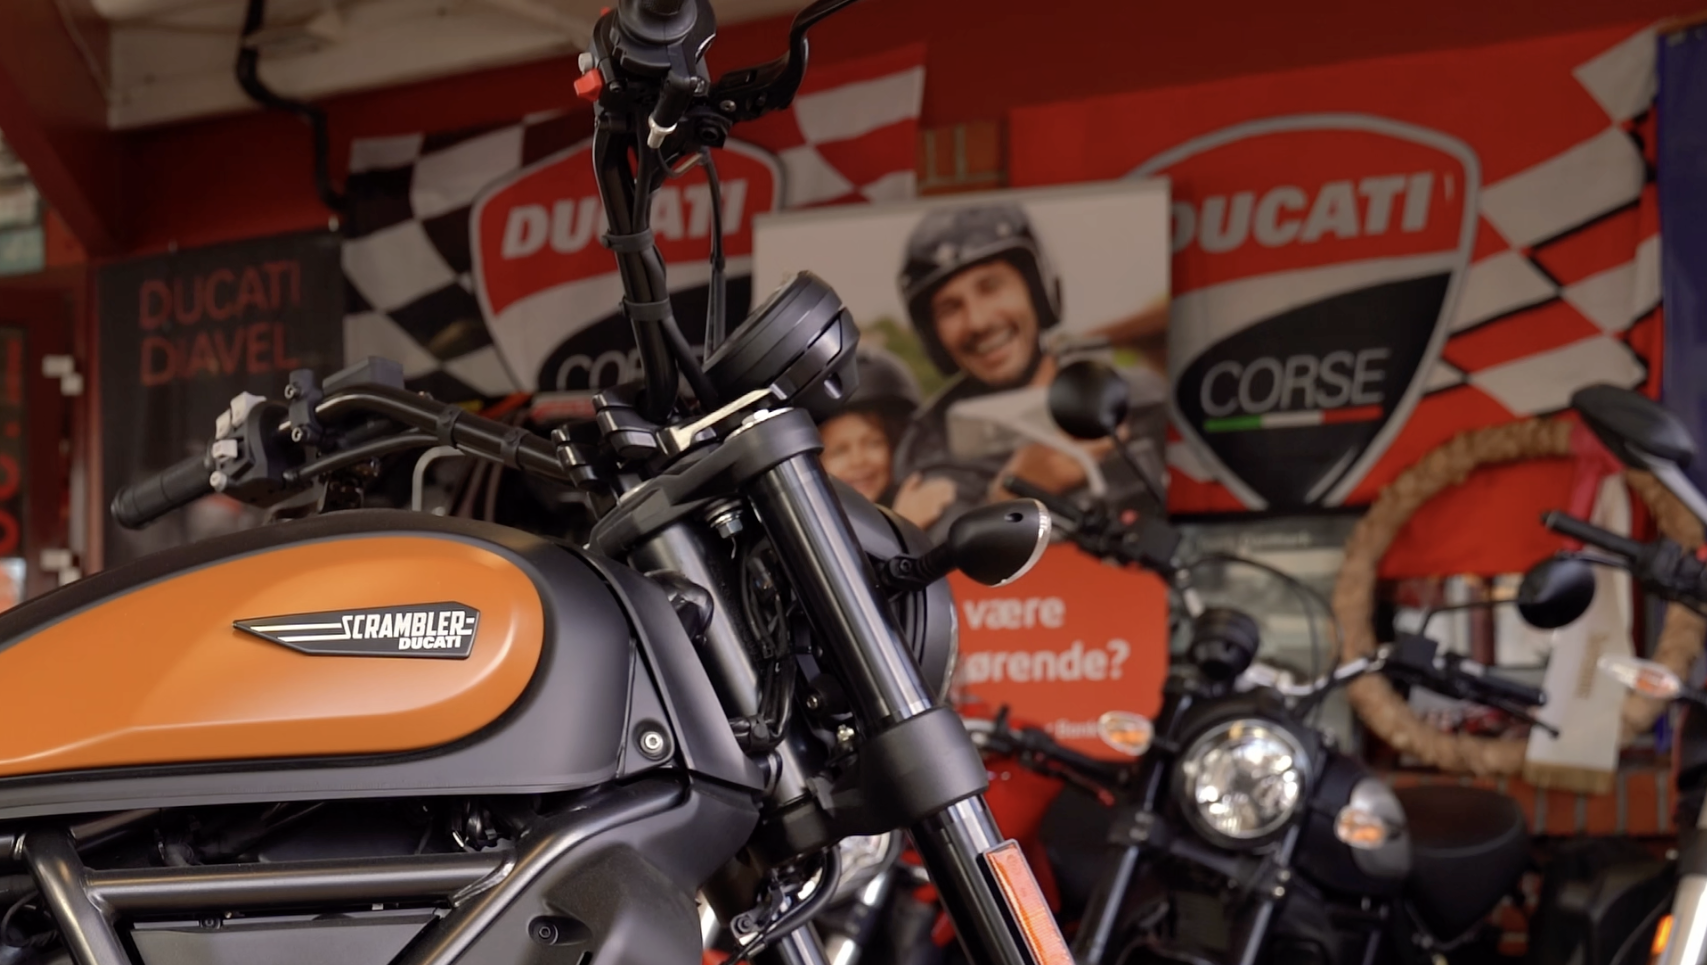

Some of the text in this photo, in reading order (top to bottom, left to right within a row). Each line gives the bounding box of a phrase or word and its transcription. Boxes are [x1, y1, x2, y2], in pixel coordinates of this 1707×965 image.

[500, 178, 748, 260] DUATI
[139, 260, 301, 331] DUCATI
[140, 322, 301, 387] DIAVEL
[1200, 348, 1389, 416] CORSE
[342, 610, 467, 640] SCRAMBLER
[962, 595, 1066, 631] være
[398, 636, 462, 650] DUCATI
[965, 637, 1132, 683] ørende?
